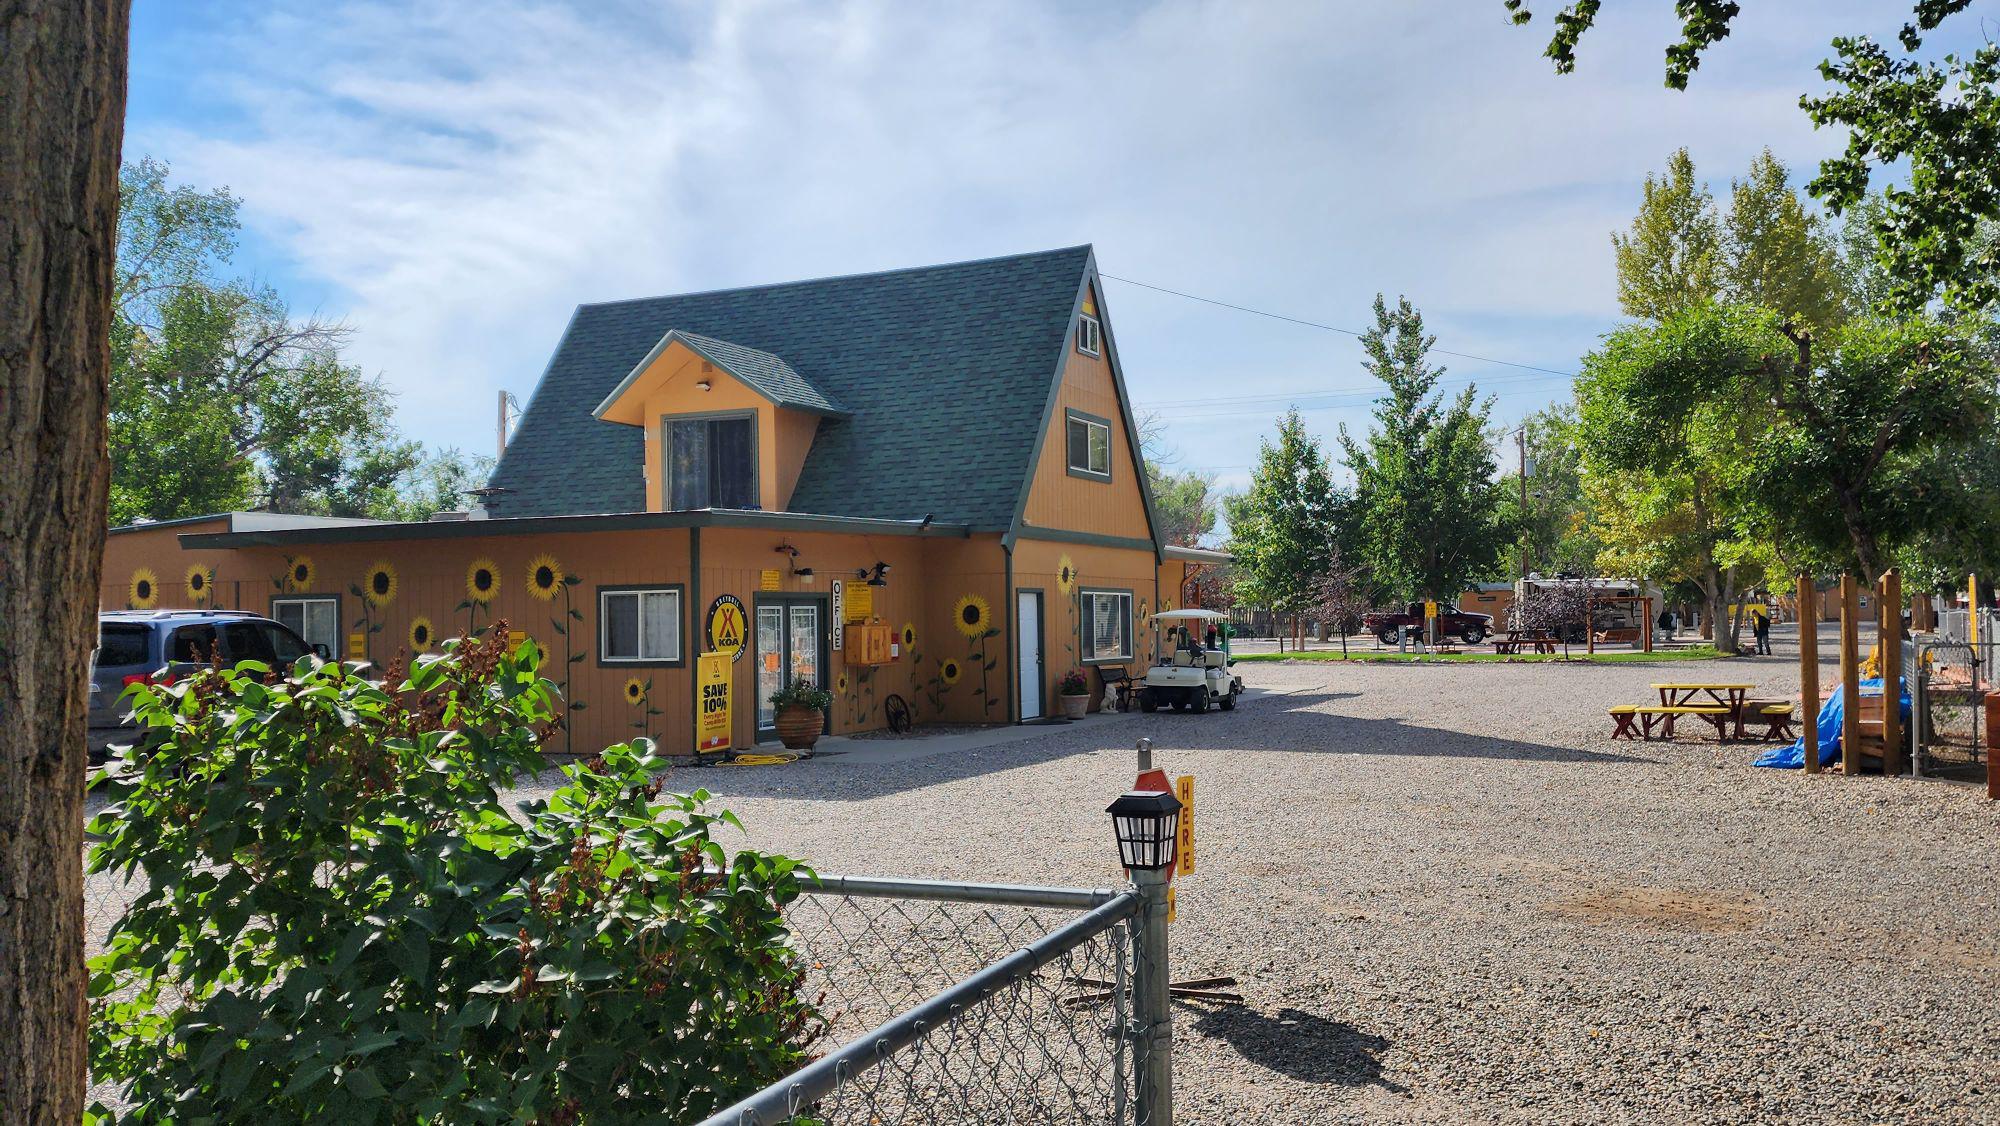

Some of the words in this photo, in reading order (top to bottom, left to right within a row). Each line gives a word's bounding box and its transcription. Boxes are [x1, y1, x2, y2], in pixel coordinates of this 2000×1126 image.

[718, 638, 739, 647] KOA
[703, 682, 728, 698] SAVE
[703, 698, 727, 713] 10%
[1182, 782, 1190, 870] HERE
